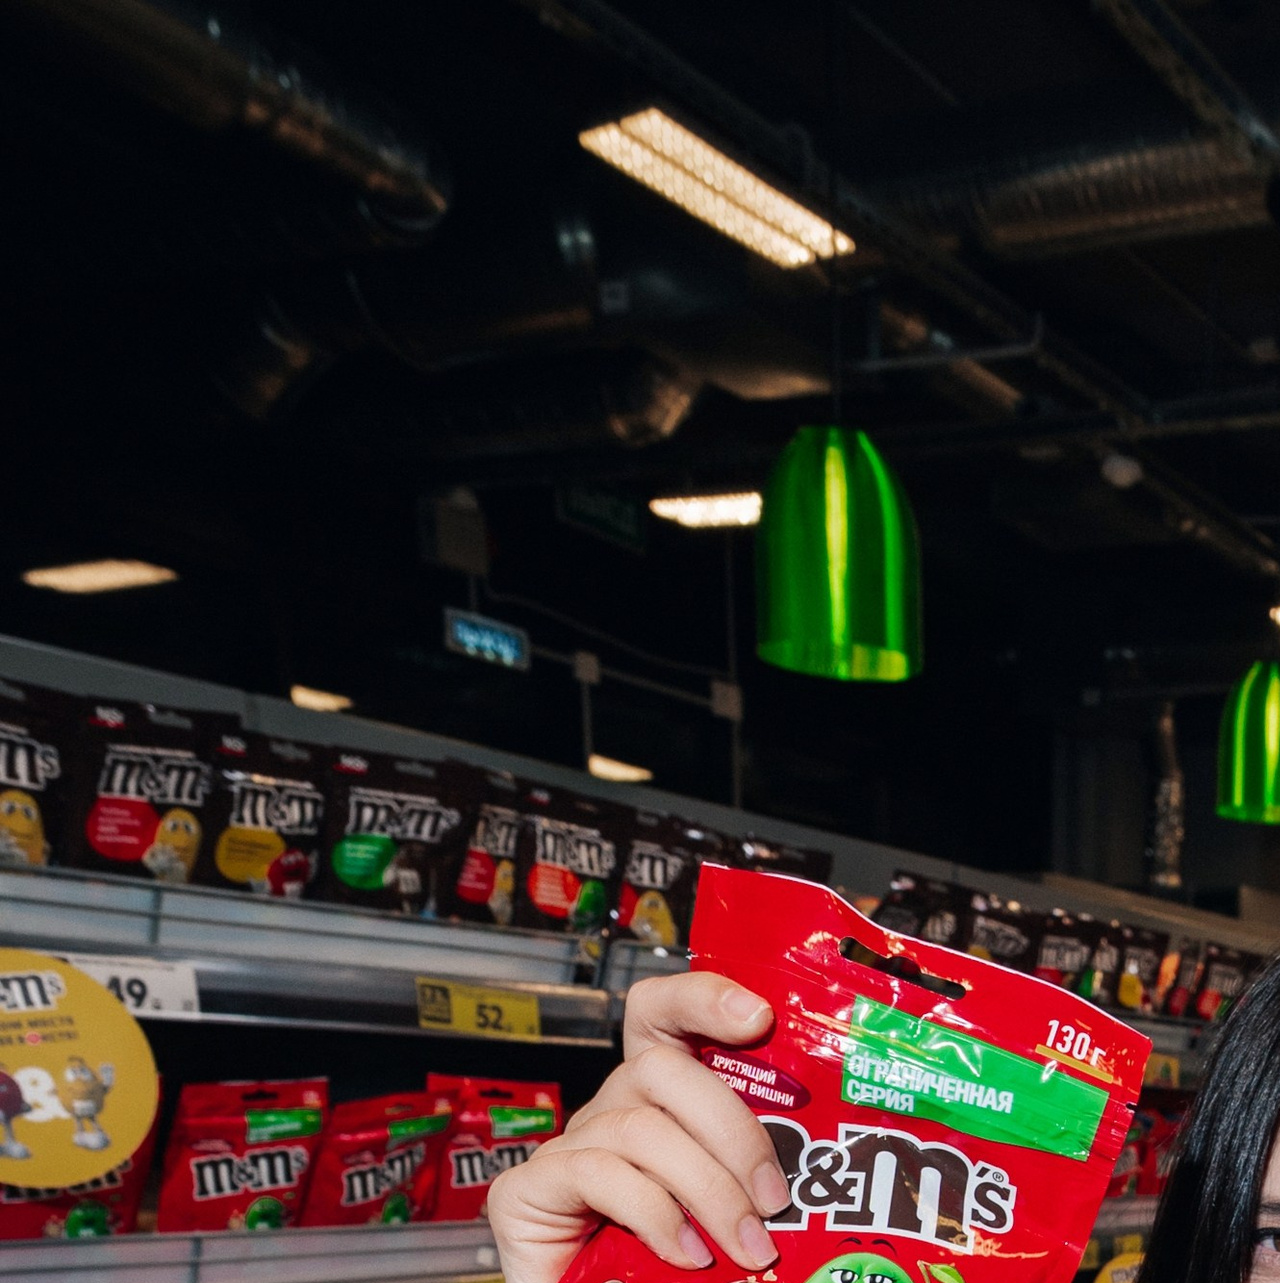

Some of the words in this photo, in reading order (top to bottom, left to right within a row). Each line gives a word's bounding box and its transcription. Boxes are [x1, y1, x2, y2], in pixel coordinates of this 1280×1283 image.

[711, 1053, 777, 1086] ХРУСТЯЩИЙ
[848, 1053, 1015, 1114] ОГРАНИЧЕННАЯ
[748, 1081, 795, 1107] ВИШНИ
[845, 1079, 915, 1113] СЕРИЯ
